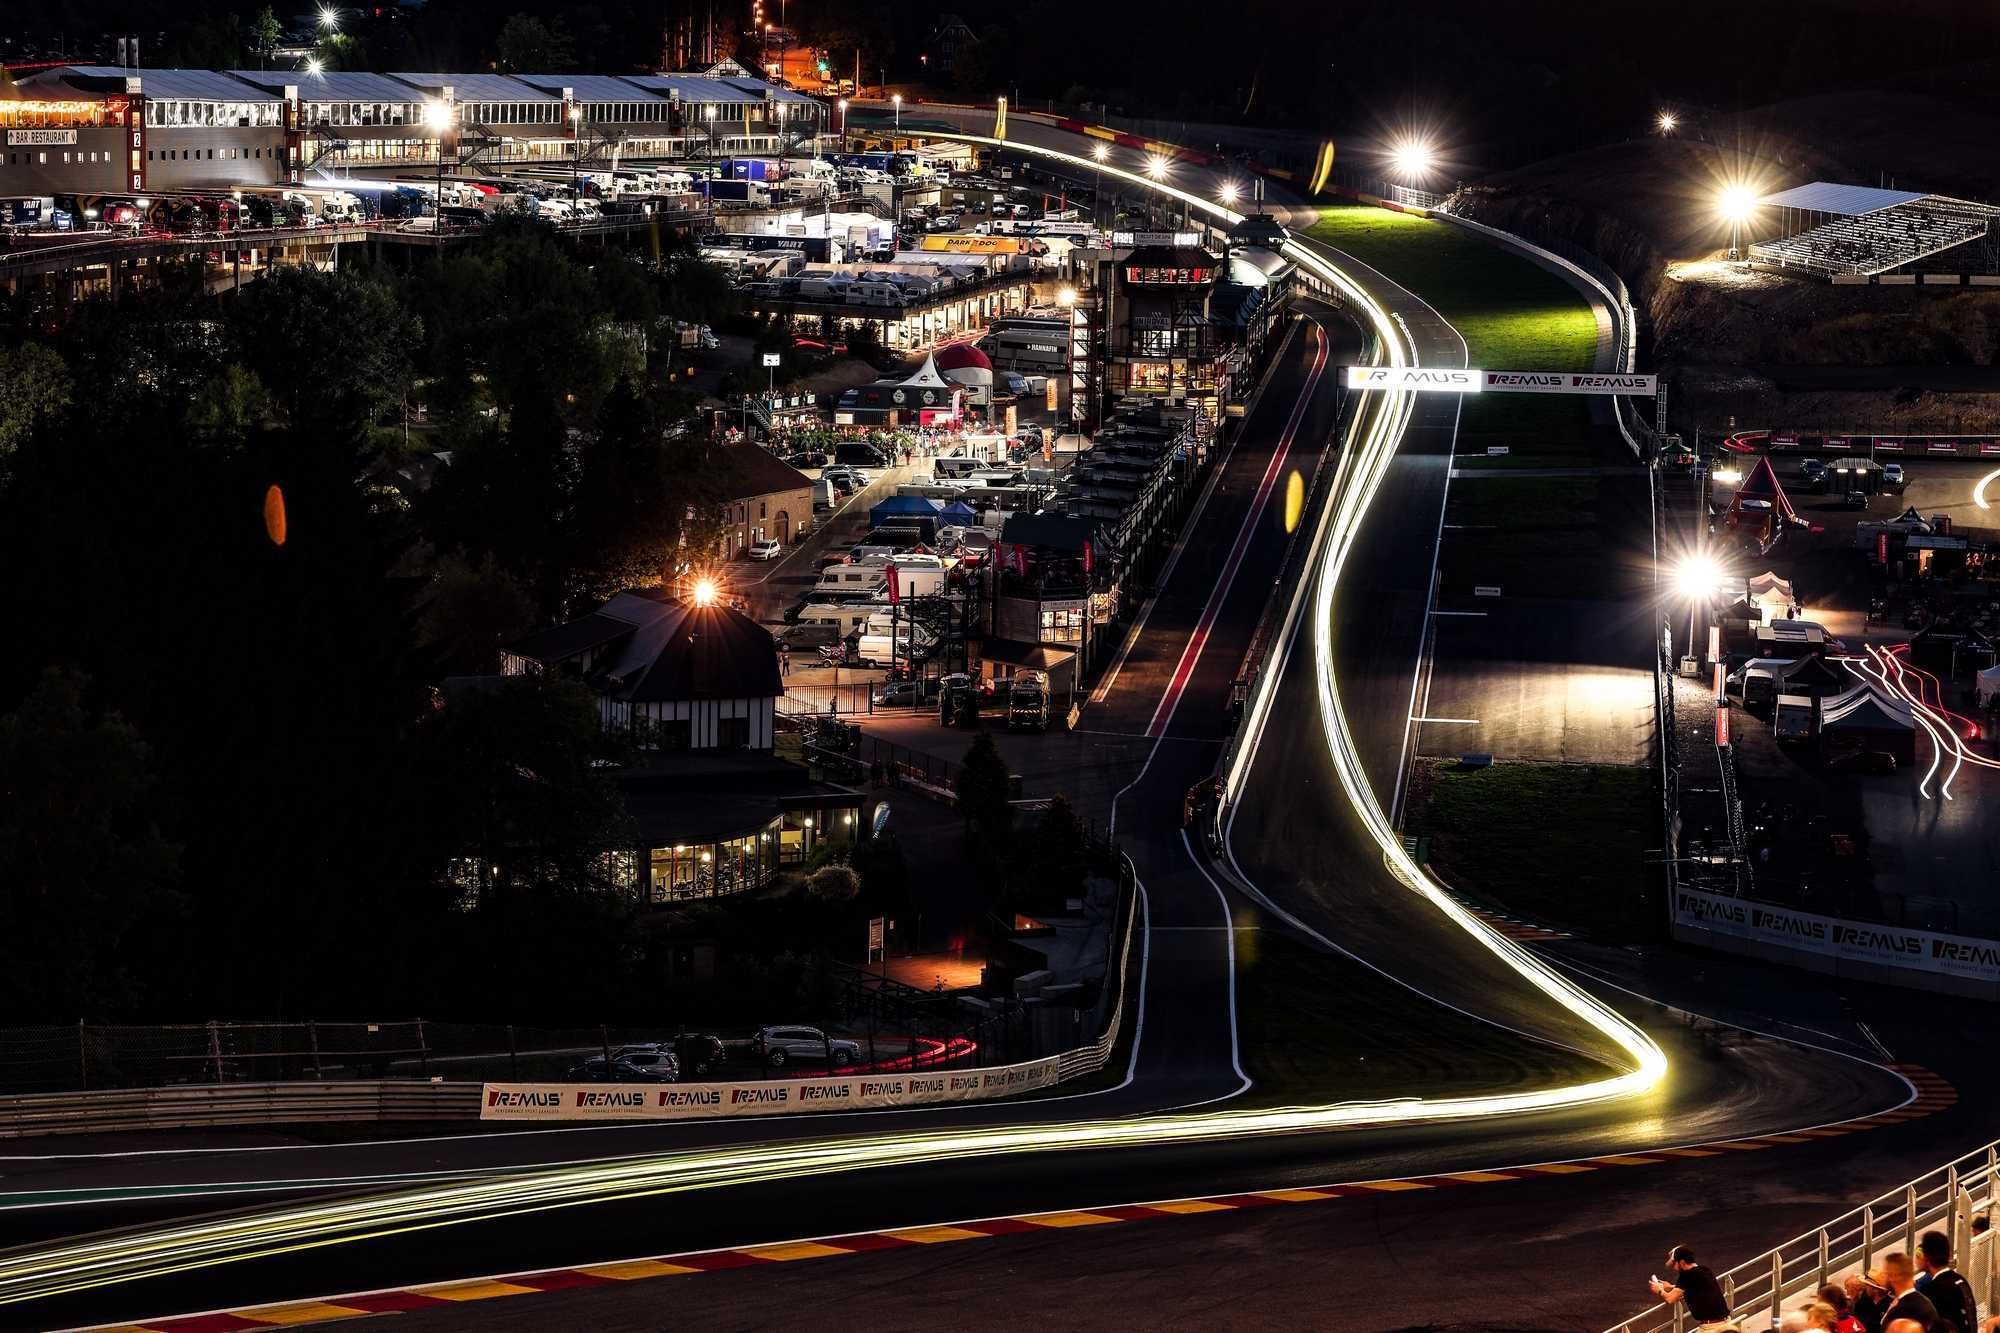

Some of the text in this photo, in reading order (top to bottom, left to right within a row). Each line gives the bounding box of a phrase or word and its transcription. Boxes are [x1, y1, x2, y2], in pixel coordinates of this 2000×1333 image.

[16, 131, 69, 144] BAR RESTAURANT
[135, 134, 140, 146] 2
[135, 176, 140, 188] 2
[23, 201, 40, 209] YART
[777, 240, 804, 248] YART
[1369, 371, 1647, 388] RMUS REMUS REMUS
[1686, 896, 1745, 923] REMUS
[1761, 913, 1825, 939] REMUS
[1842, 929, 1922, 954] REMUS
[1941, 942, 2000, 966] REMU
[496, 1092, 561, 1107] REMUS
[584, 1092, 644, 1107] REMUS
[665, 1091, 721, 1106] REMUS
[736, 1088, 788, 1103] REMUS
[804, 1085, 850, 1099] REMUS
[865, 1082, 903, 1096] REMUS
[911, 1079, 944, 1093] REMUS
[953, 1076, 979, 1090] REMUS
